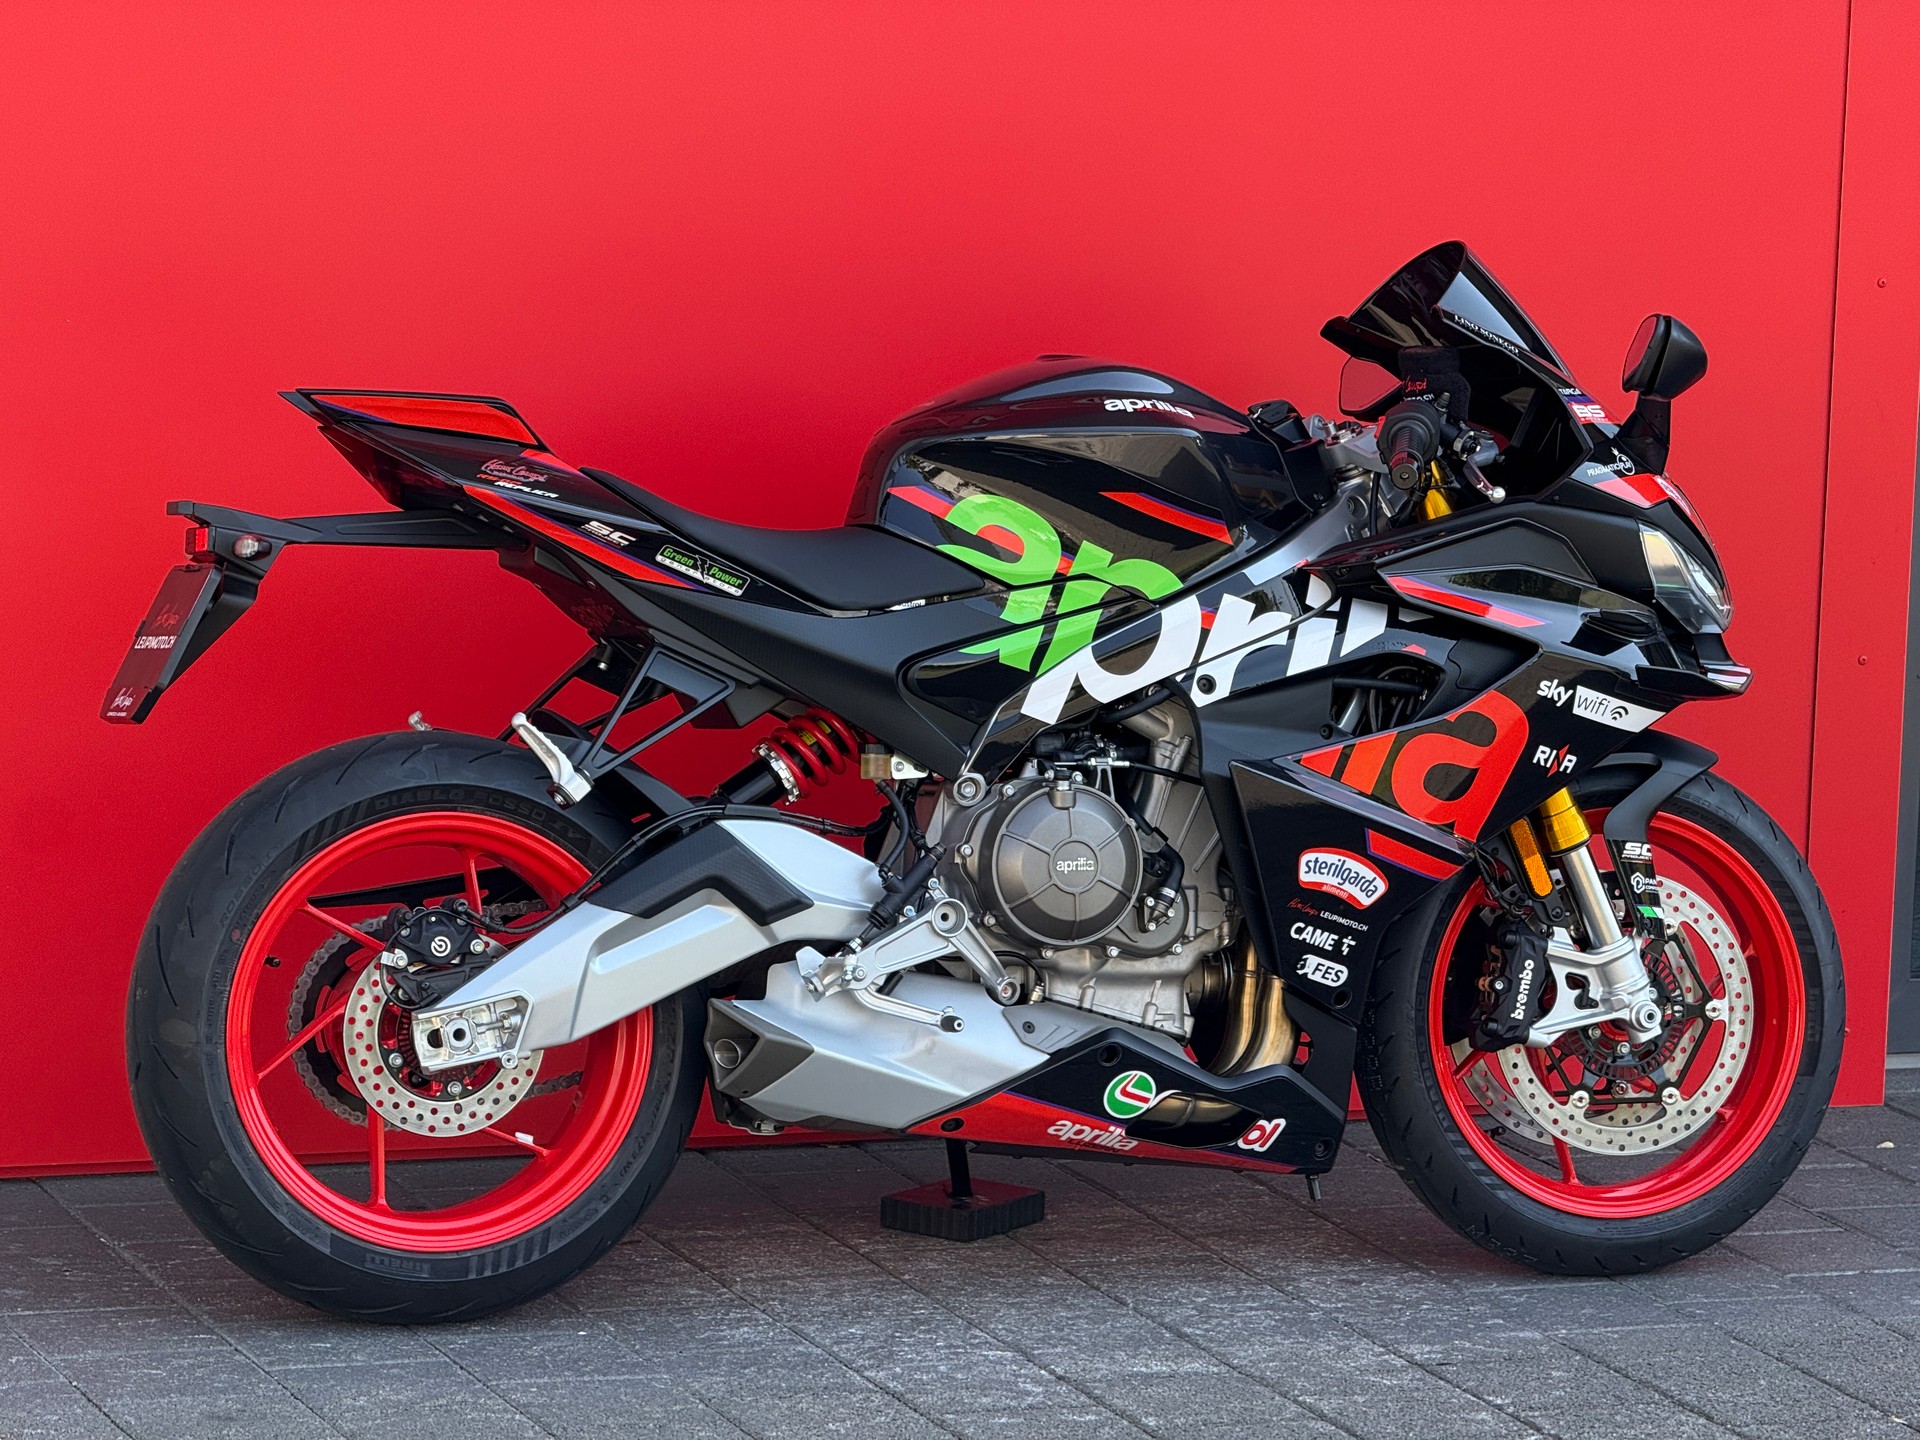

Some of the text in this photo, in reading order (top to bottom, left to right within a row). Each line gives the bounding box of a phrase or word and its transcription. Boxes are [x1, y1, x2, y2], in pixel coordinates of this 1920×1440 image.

[1103, 398, 1195, 419] aprilia
[1572, 404, 1605, 418] BS
[663, 547, 743, 587] Green Power
[1536, 679, 1611, 717] sky wifi
[1056, 857, 1095, 874] aprilia
[1304, 857, 1378, 898] sterilgarda
[1321, 884, 1349, 899] alimenti
[1320, 910, 1369, 932] LEUPIMOTO.CH
[1290, 922, 1339, 951] CAME
[1311, 962, 1344, 983] FES
[1510, 959, 1535, 1020] brembo
[1046, 1119, 1139, 1151] aprilia
